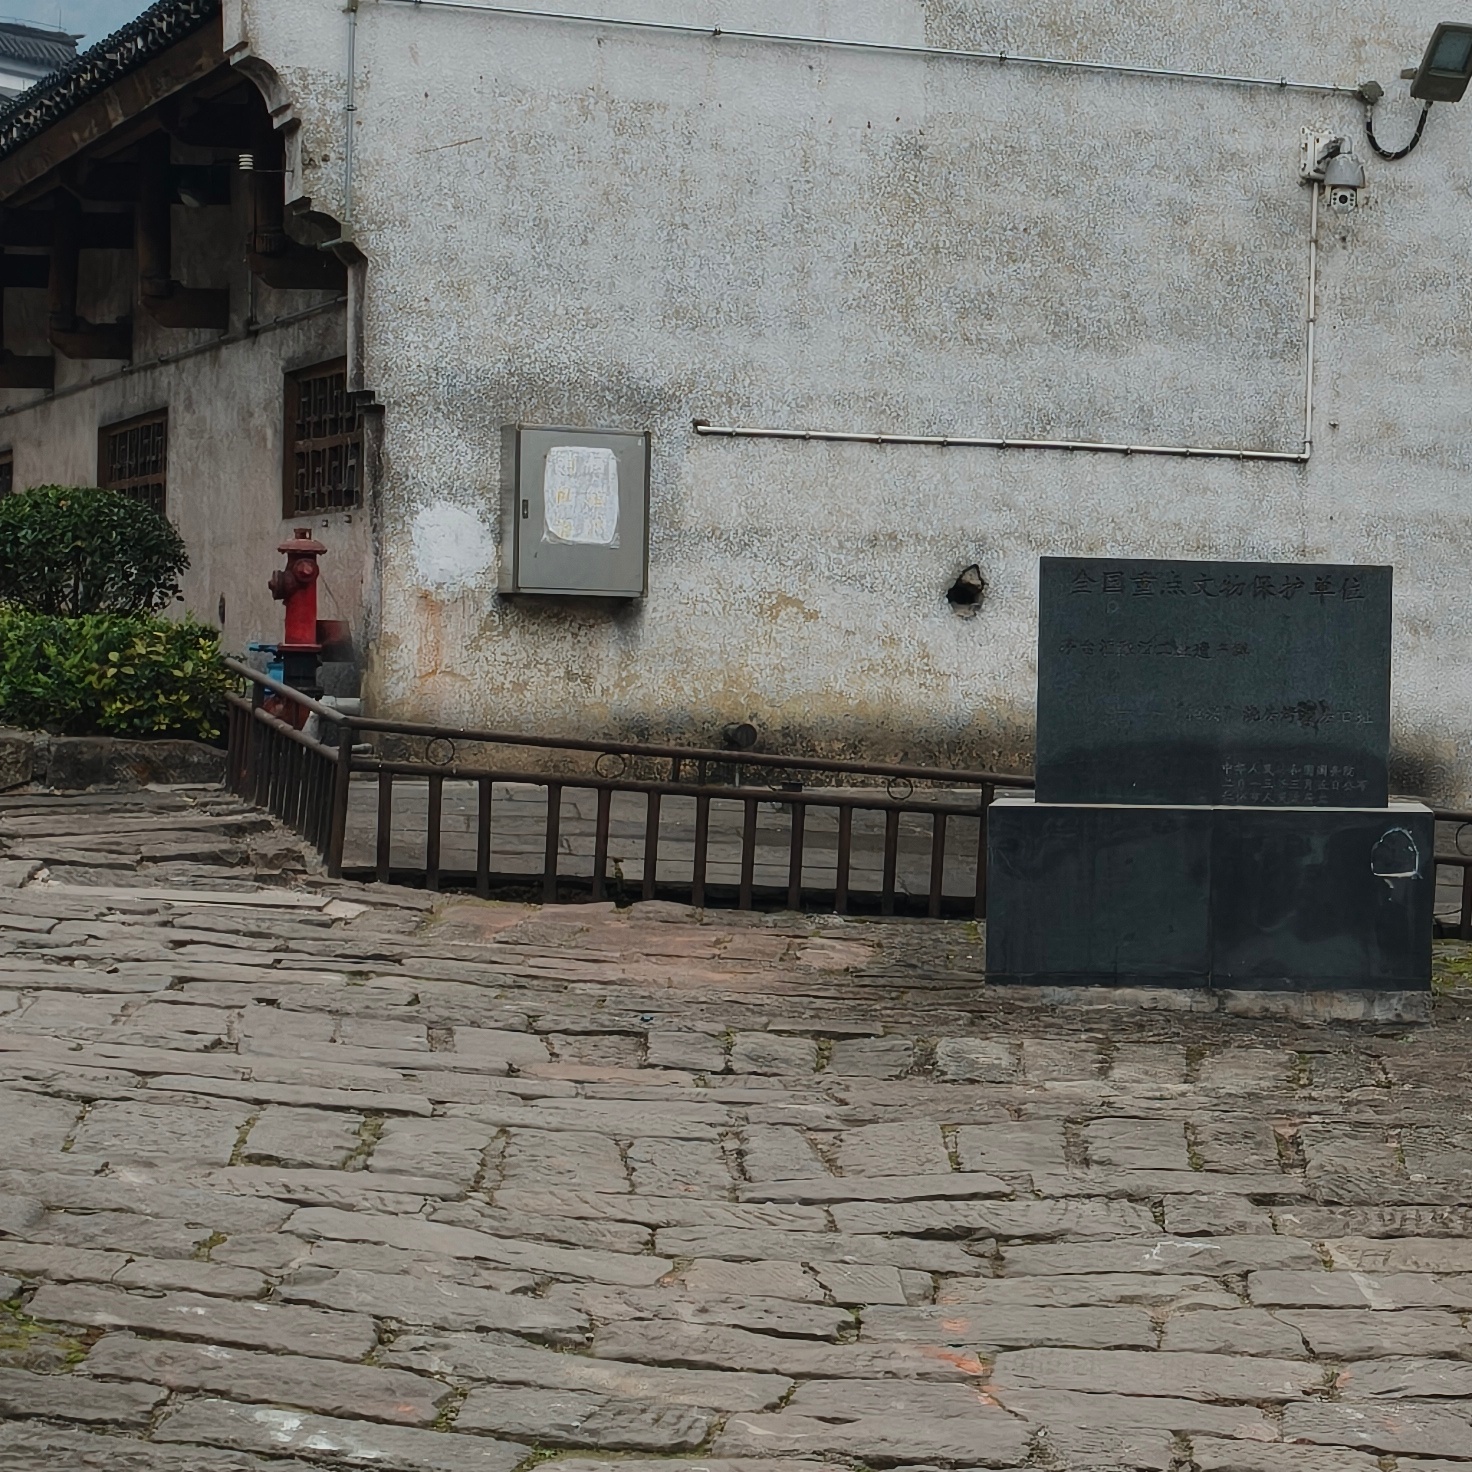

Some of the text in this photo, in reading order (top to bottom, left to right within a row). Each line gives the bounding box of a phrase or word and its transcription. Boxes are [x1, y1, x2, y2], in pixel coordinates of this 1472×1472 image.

[1069, 568, 1367, 605] 全国重点文物保护单位
[1221, 761, 1356, 779] 中华人民和国国务院
